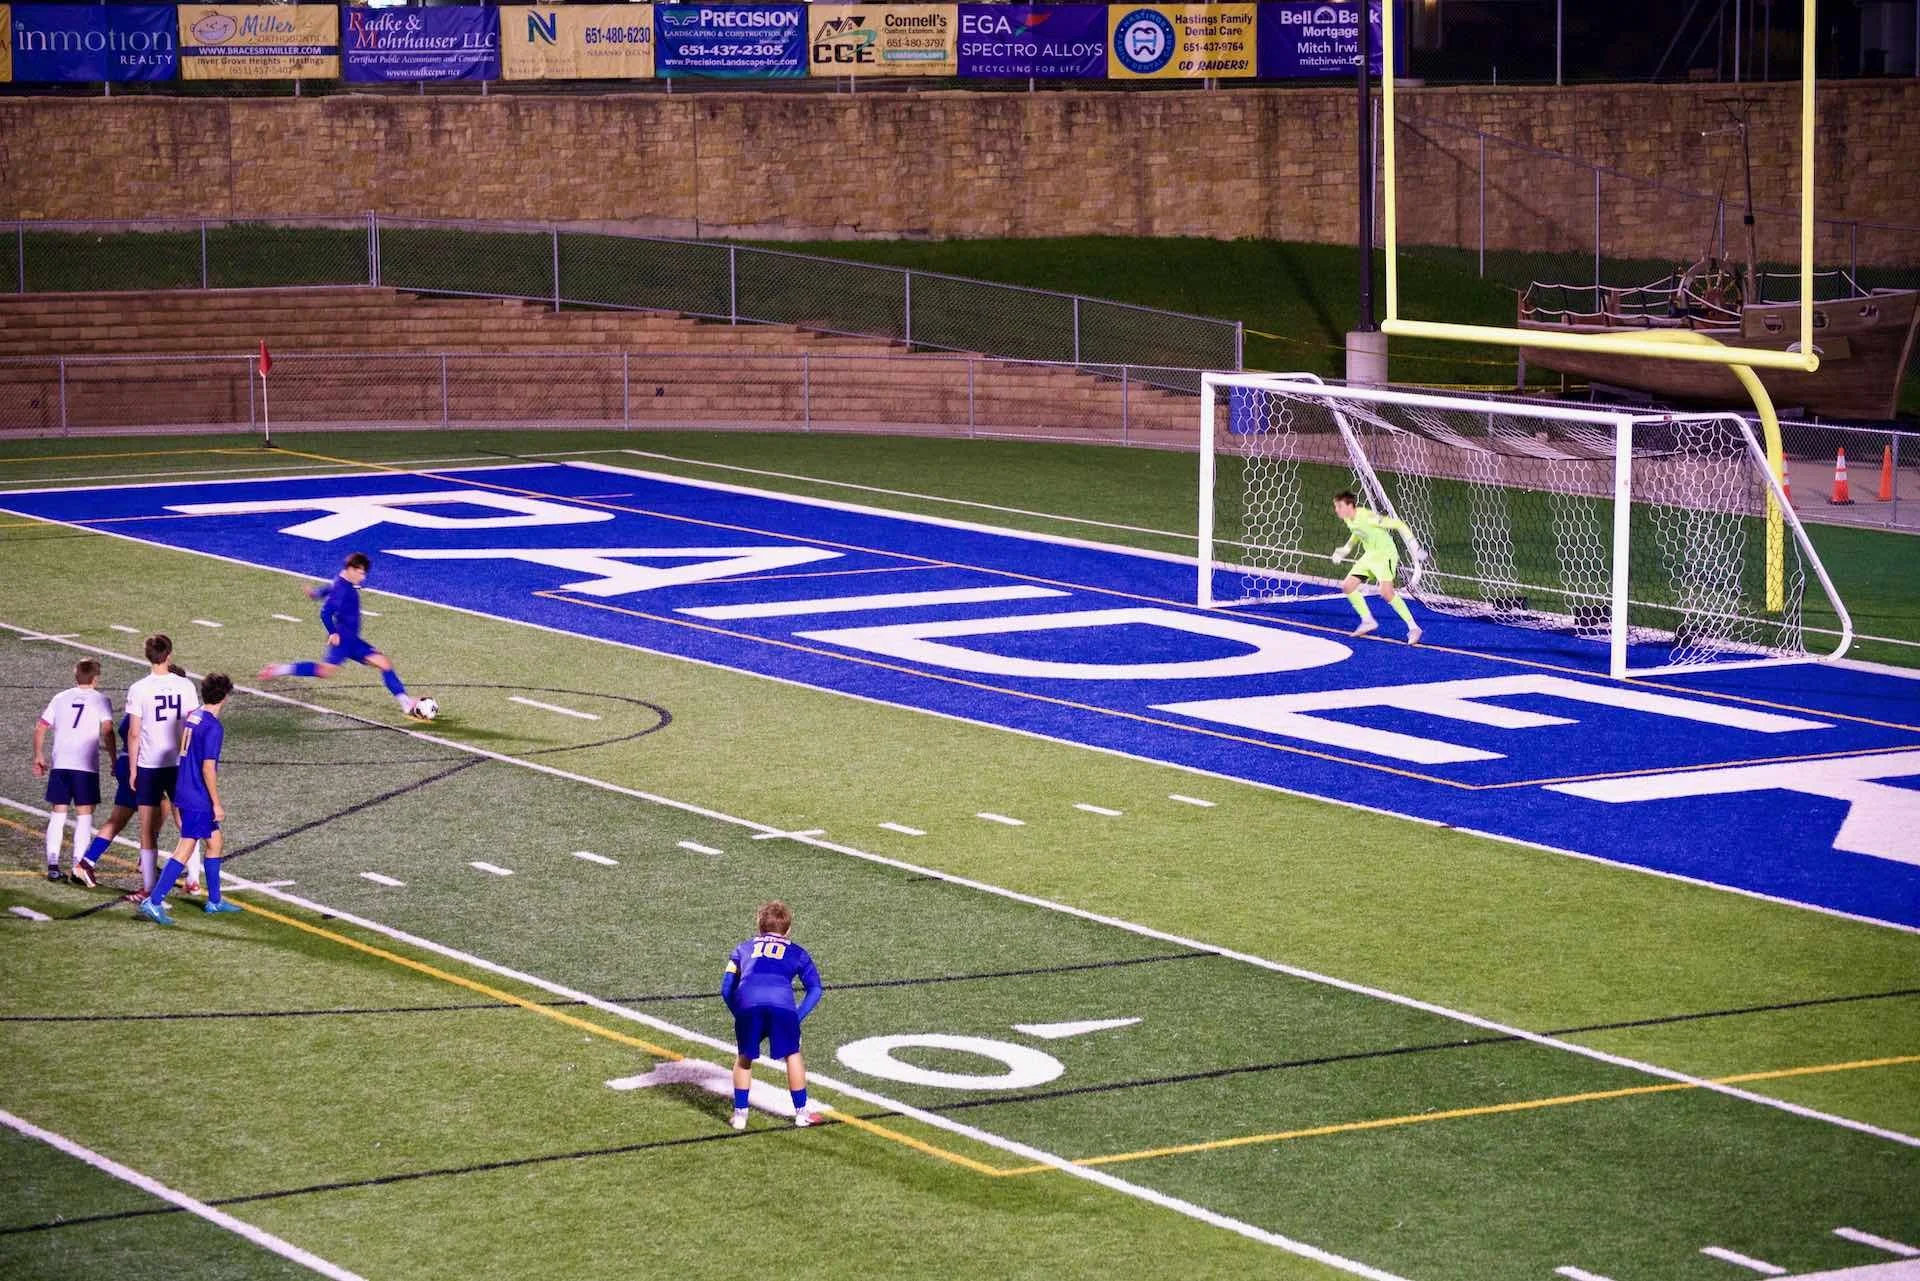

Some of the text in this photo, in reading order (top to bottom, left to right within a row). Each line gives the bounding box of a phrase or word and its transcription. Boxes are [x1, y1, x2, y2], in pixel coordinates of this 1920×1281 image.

[349, 12, 423, 31] Radke &
[700, 9, 799, 27] PRECISION
[885, 14, 947, 27] Connell's
[1175, 14, 1253, 25] Hastings Family
[1281, 9, 1381, 25] Bell Bak
[240, 15, 295, 36] Miller
[962, 15, 1012, 34] EGA
[1185, 26, 1243, 36] Dental Care
[16, 22, 173, 51] inmotion
[664, 30, 716, 38] LANDSCAPING
[1303, 26, 1359, 39] Mortgage
[354, 31, 496, 49] Mohrhauser LLC
[886, 39, 945, 48] 651-480-3797
[1183, 42, 1244, 51] 651-437-9764
[198, 47, 322, 55] WWW.BRACESBYMILLER.COM
[678, 45, 783, 56] 651-437-2305
[813, 44, 875, 64] CCE
[962, 43, 1103, 57] SPECTRO ALLOYS
[1298, 42, 1358, 54] Mitch Irwi
[120, 55, 173, 65] REALTY
[220, 57, 247, 65] Grove
[249, 57, 281, 66] Heights
[349, 55, 378, 65] Certified
[379, 55, 400, 64] Public
[1179, 60, 1249, 71] GO RAIDERS!
[971, 65, 1081, 73] RECYCLING FOR LIFE
[155, 694, 182, 722] 24
[72, 703, 85, 729] 7
[751, 941, 787, 960] 10
